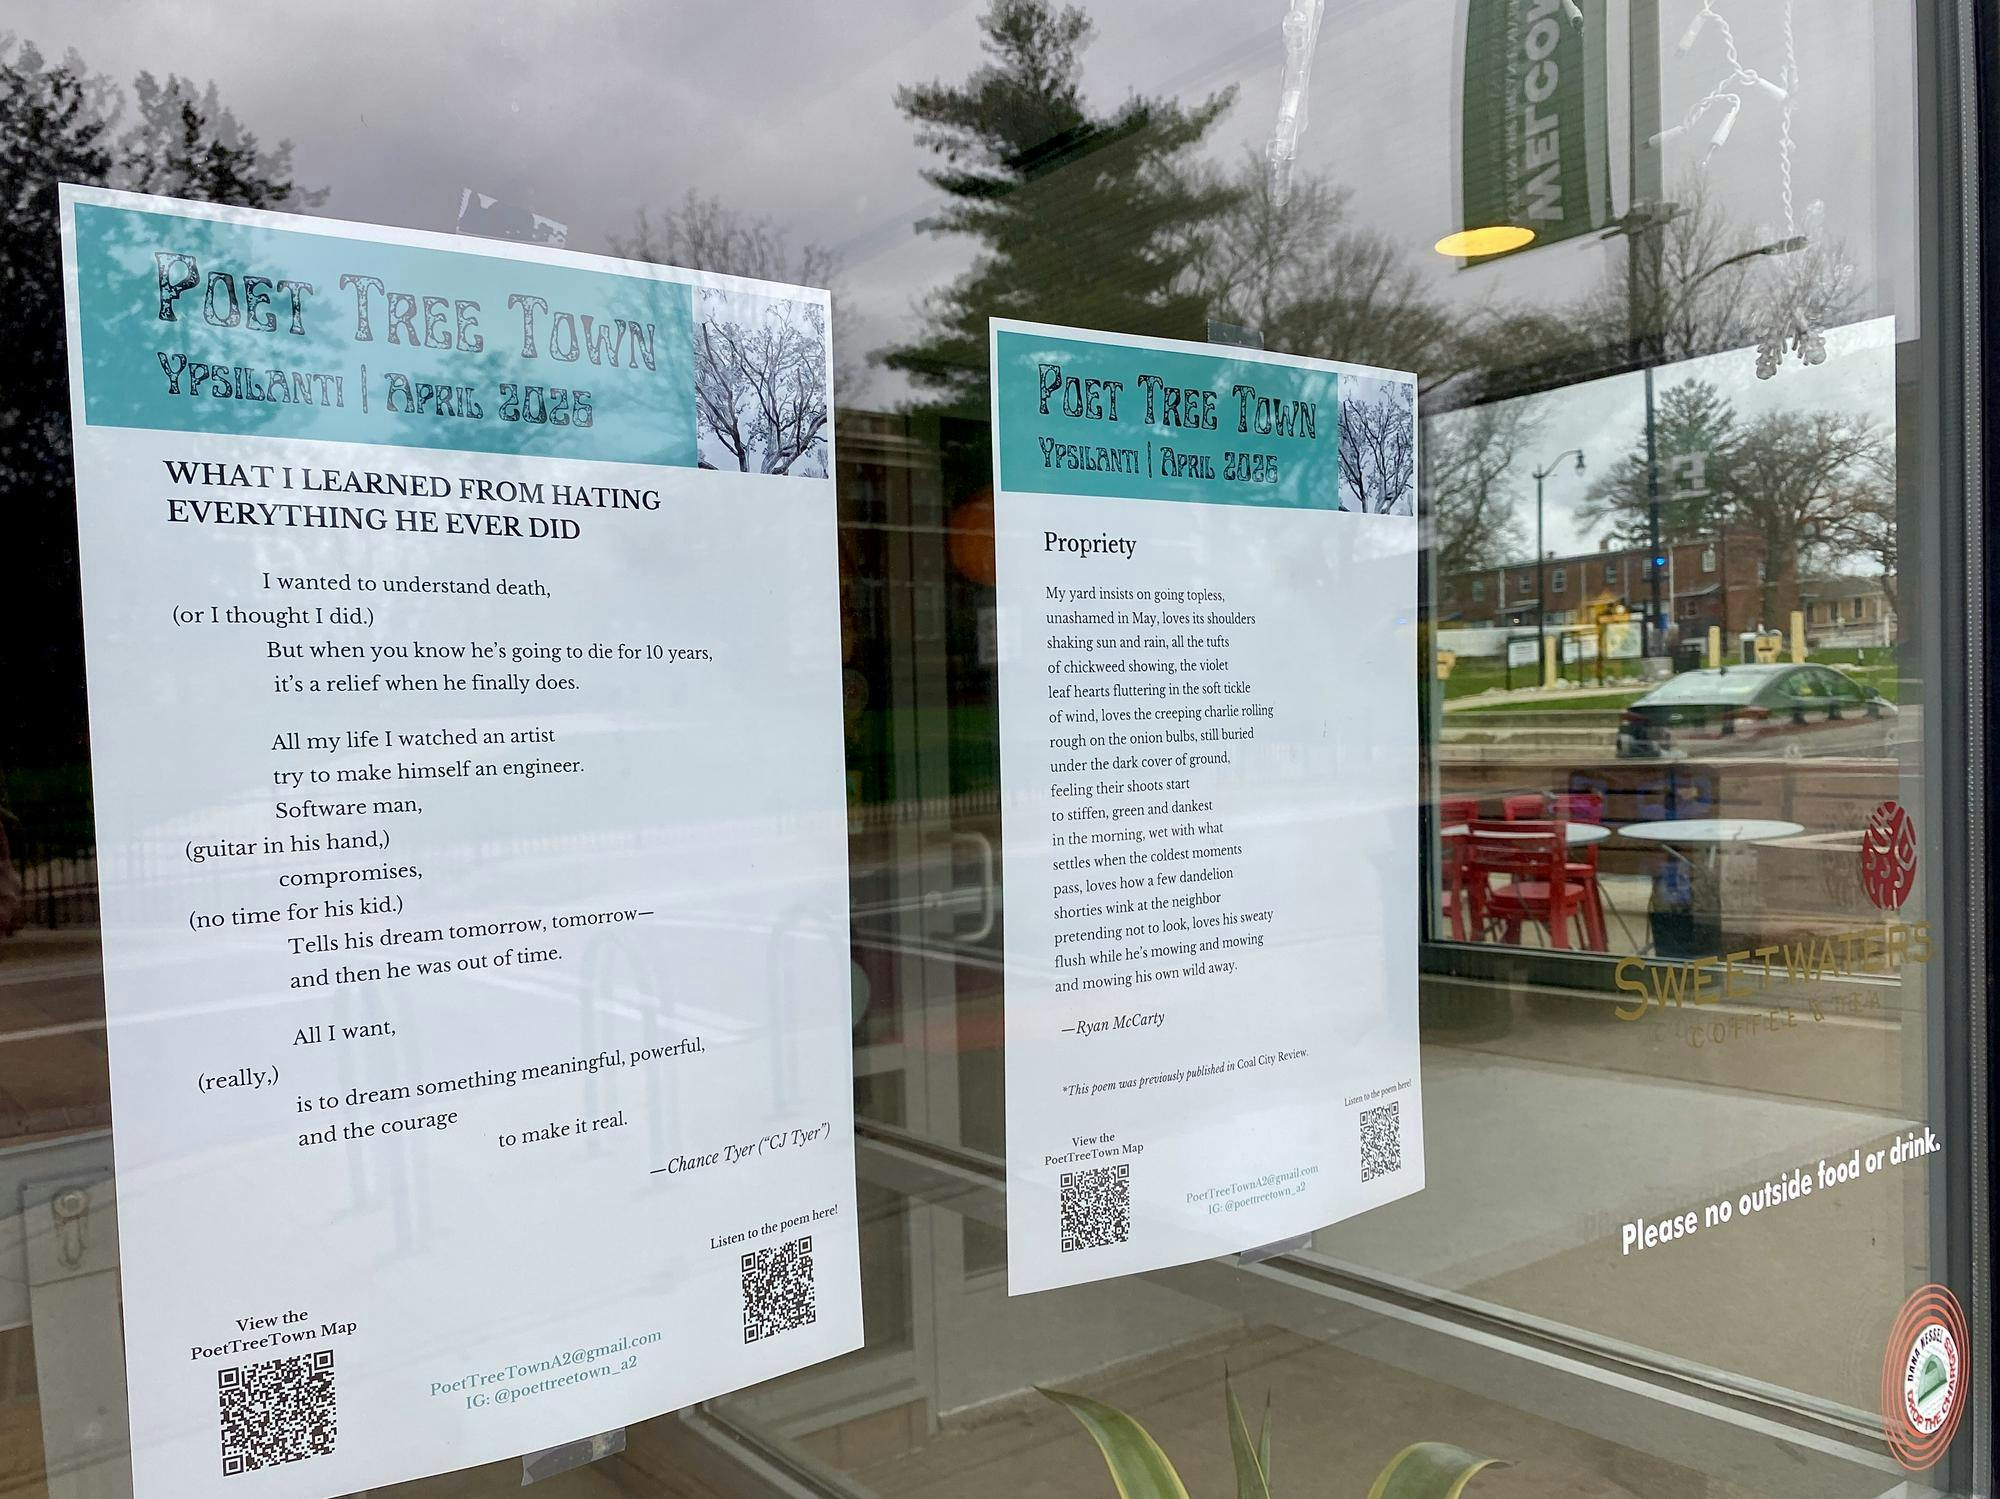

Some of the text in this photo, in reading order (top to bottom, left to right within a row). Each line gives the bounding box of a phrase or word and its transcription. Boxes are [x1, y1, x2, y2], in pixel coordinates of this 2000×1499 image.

[499, 383, 593, 427] 2026
[1223, 452, 1278, 483] 2026
[162, 460, 661, 511] WHAT I LEARNED FROM HATING
[166, 498, 581, 540] EVERYTHING HE EVER DID
[1043, 531, 1137, 560] Propriety
[262, 572, 551, 599] I wanted to understand death,
[1046, 586, 1225, 604] My yard insists on going topless,
[173, 605, 374, 629] (or I thought I did.)
[1046, 610, 1256, 628] unashamed in May, loves its shoulders
[1047, 658, 1229, 675] of chickweed showing, the violet
[274, 673, 580, 695] it’s a relief when he finally does.
[1050, 779, 1190, 799] feeling their shoots start
[1051, 799, 1213, 822] to stiffen, green and dankest
[185, 829, 390, 864] (guitar in his hand,)
[1053, 845, 1243, 871] settles when the coldest moments
[279, 862, 422, 889] compromises,
[287, 934, 339, 955] Tells
[344, 931, 374, 950] his
[380, 928, 444, 946] dream
[448, 919, 547, 939] tomorrow,
[1054, 910, 1274, 948] pretending not to look, loves his sweaty
[1112, 1012, 1165, 1030] McCarty
[198, 1064, 279, 1094] (really,)
[296, 1036, 705, 1113] is to dream something meaningful, powerful,
[1090, 1082, 1116, 1096] poem
[1118, 1079, 1137, 1089] was
[1138, 1069, 1185, 1089] previously
[1185, 1061, 1225, 1082] published
[1226, 1060, 1235, 1072] in
[1237, 1056, 1256, 1070] Coal
[1258, 1054, 1276, 1066] City
[1278, 1048, 1309, 1062] Review.
[1344, 1094, 1363, 1107] Listen
[1370, 1089, 1380, 1099] the
[1380, 1085, 1397, 1098] poem
[723, 1143, 756, 1164] Tyer
[1072, 1132, 1115, 1147] View the
[1045, 1143, 1144, 1166] PoetTreeTown Map
[1622, 1127, 1941, 1255] Please no outside food or drink.
[710, 1203, 838, 1250] Listen to the poem here!
[235, 1310, 308, 1332] View the
[191, 1322, 357, 1361] PoetTreeTown Map
[1907, 1348, 1920, 1381] DANA
[1920, 1328, 1943, 1350] NESSEL
[431, 1332, 661, 1396] PoetTreeTownA2@gmail.com
[466, 1355, 637, 1409] IG: @poettreetown_a2
[1907, 1389, 1923, 1424] DROP
[1925, 1411, 1942, 1430] THE
